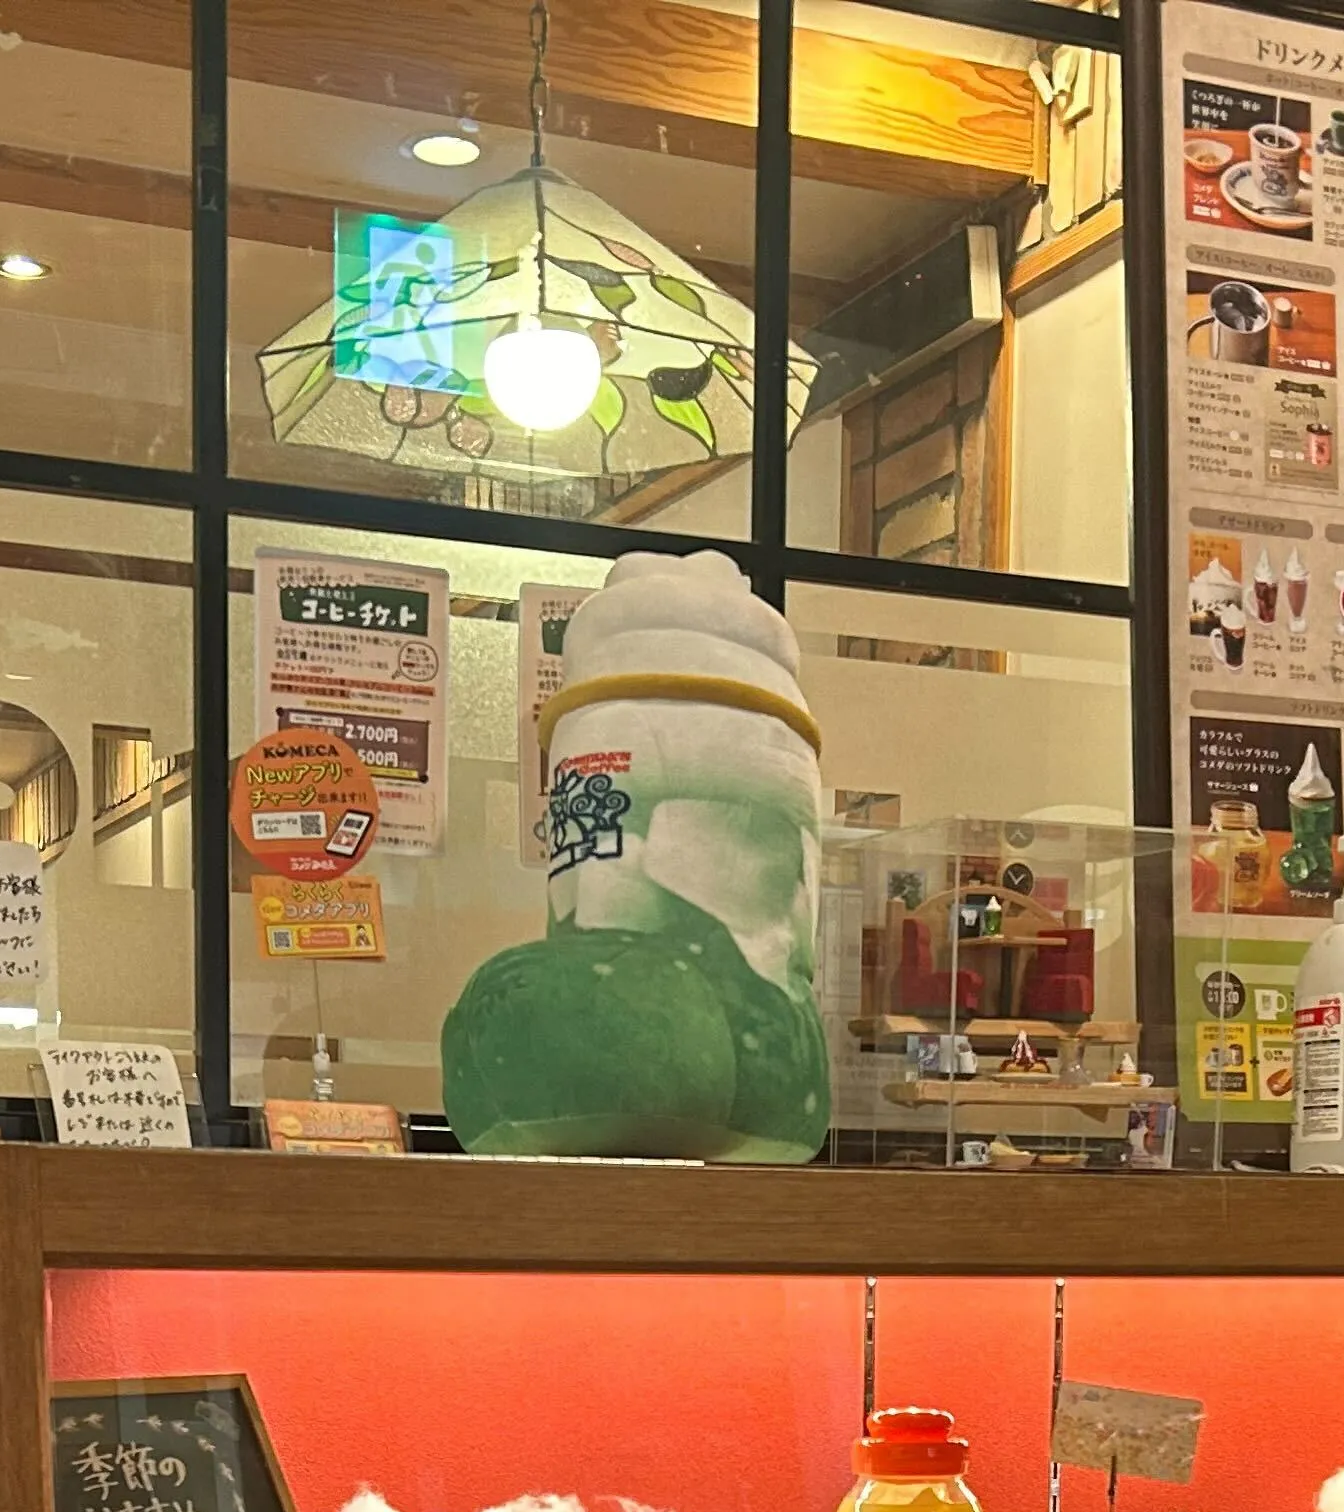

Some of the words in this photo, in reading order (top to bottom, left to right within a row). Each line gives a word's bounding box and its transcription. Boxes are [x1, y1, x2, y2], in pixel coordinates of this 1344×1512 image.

[301, 599, 418, 628] コーヒーチケット
[71, 1440, 187, 1501] 季節の
